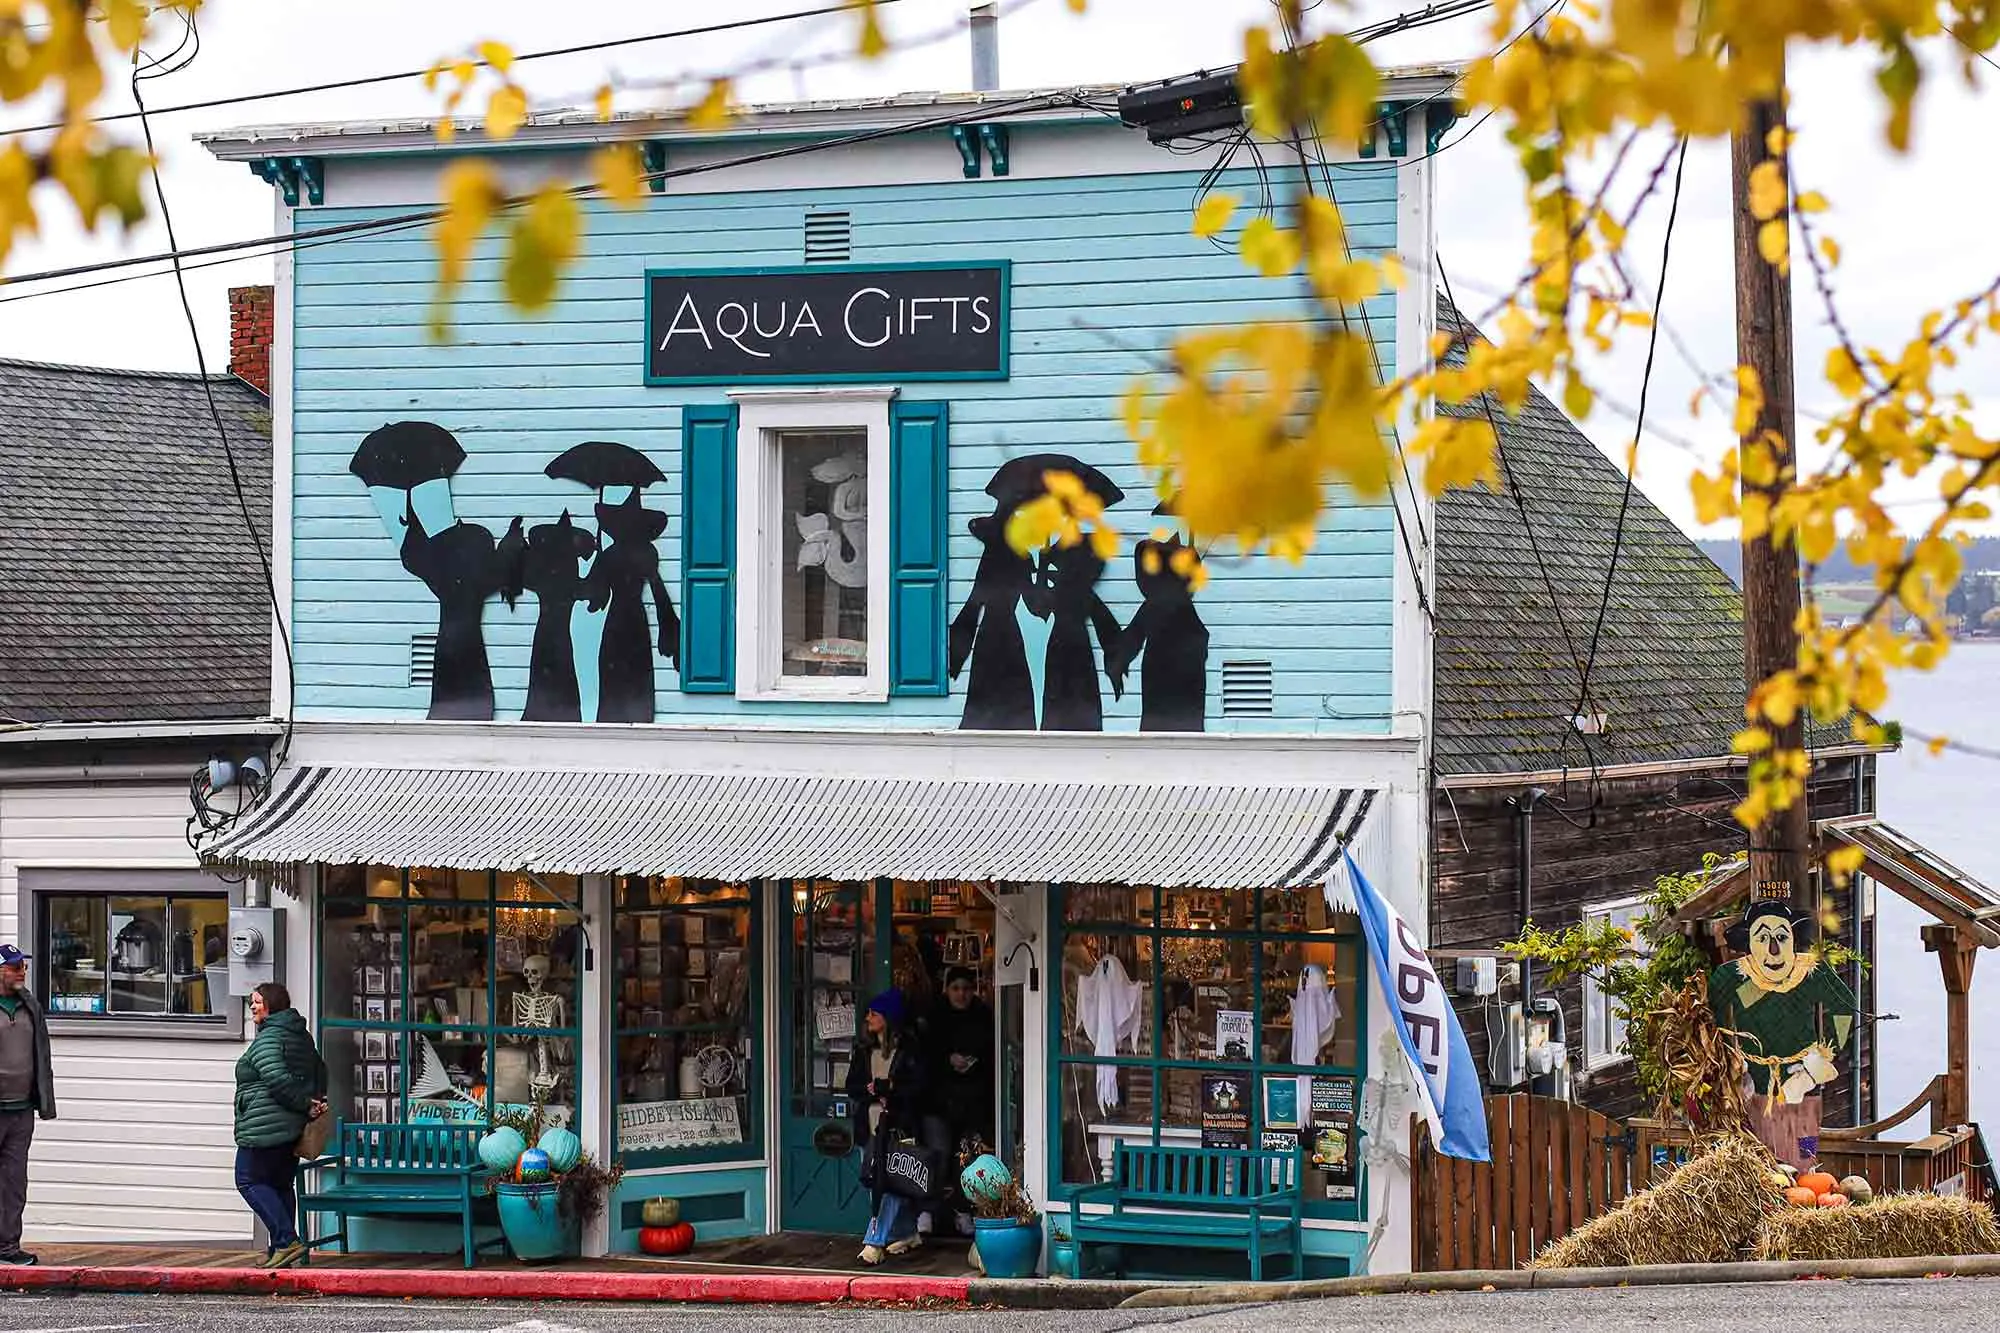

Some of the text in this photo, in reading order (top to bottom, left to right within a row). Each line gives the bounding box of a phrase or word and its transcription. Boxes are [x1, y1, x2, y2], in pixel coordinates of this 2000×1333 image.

[659, 287, 992, 357] AQUA GIFTS
[620, 1101, 736, 1128] HIDBEY ISLAND
[1312, 1101, 1329, 1109] LOVE
[657, 1132, 664, 1142] N
[727, 1127, 736, 1137] W
[887, 1152, 929, 1193] COMA
